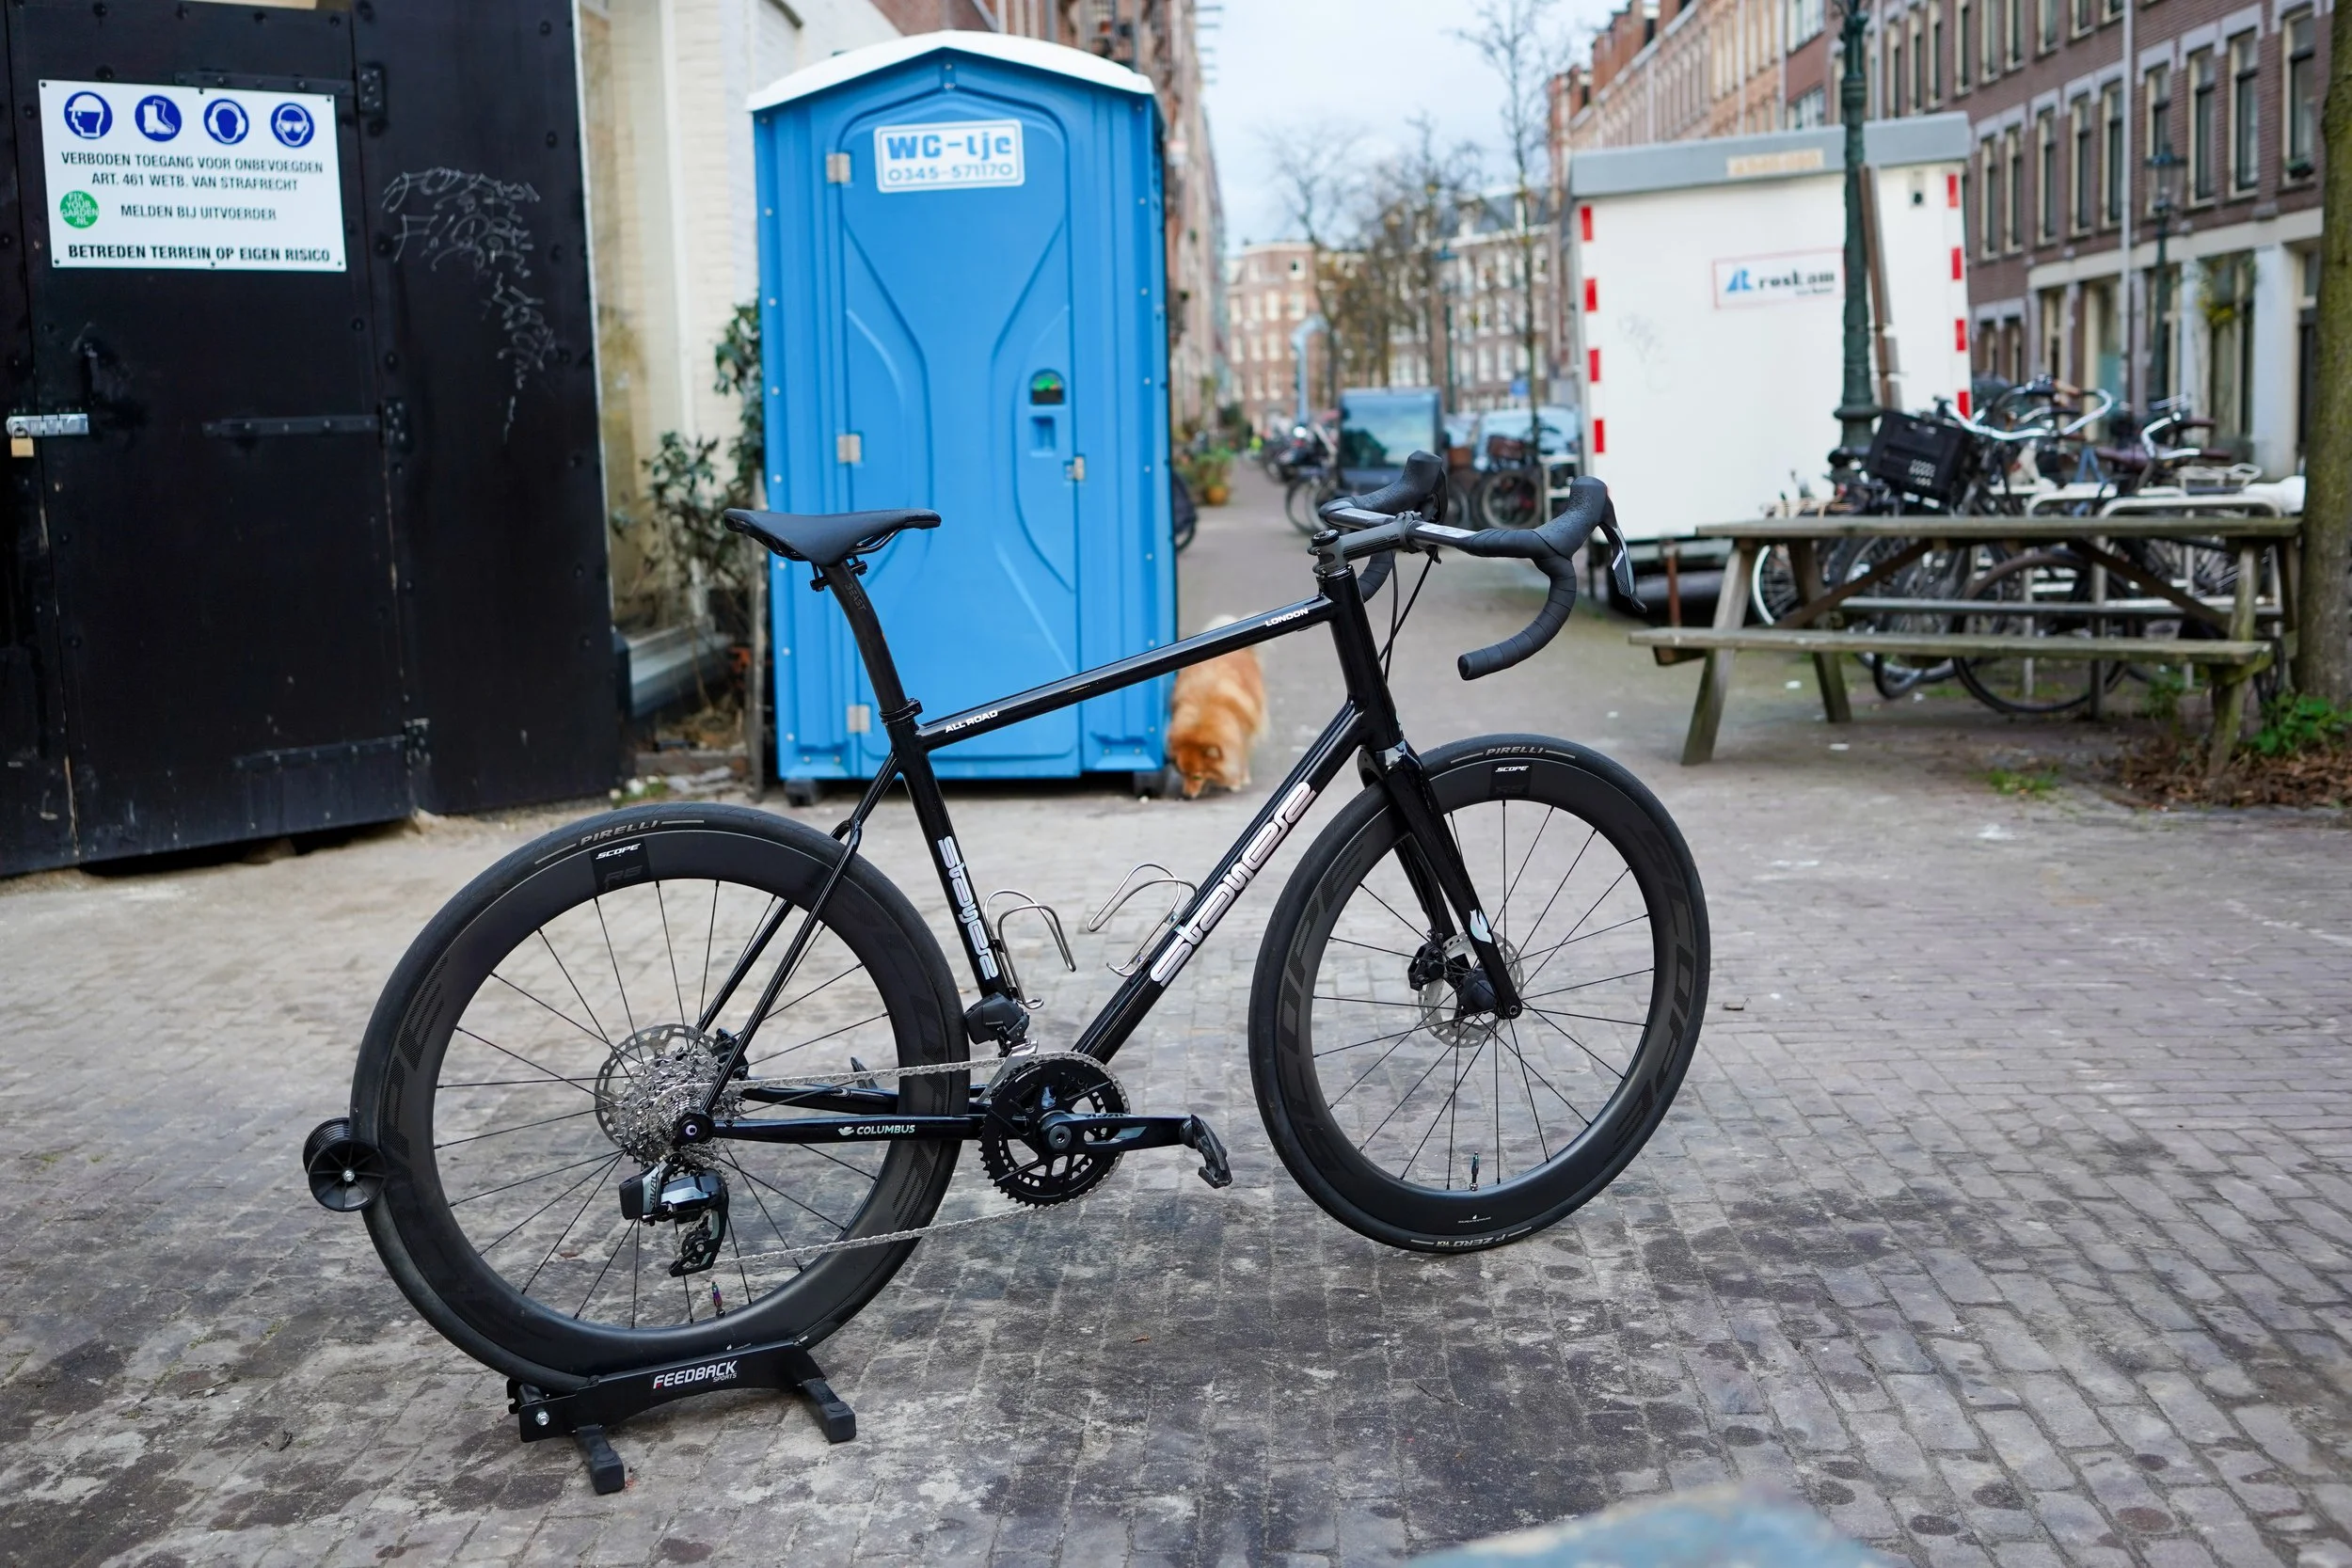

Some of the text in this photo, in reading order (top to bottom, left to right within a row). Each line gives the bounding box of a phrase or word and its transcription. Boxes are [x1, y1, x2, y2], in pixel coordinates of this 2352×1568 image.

[61, 151, 323, 173] VERBODEN TOEGANG VOOR ONBEVOEGDEN
[91, 172, 298, 191] ART. 461 WETB. VAN STRAFRECHT
[68, 192, 84, 201] FIX
[66, 199, 91, 209] YOUR
[60, 208, 100, 217] GARDEN
[120, 204, 278, 220] MELDEN BIJ UITVOERDER
[68, 245, 330, 261] BETREDEN TERREIN OP EIGEN RISICO
[1264, 608, 1310, 627] LONDON
[1486, 745, 1544, 756] PIRELLI
[1495, 765, 1530, 773] SCOPE
[580, 820, 658, 845] PIRELLI
[596, 844, 641, 859] SCOPE
[856, 1124, 915, 1135] COLUMBUS
[1454, 1237, 1494, 1247] ZERO
[1495, 1233, 1506, 1242] P
[653, 1360, 738, 1389] FEEDBACK
[712, 1372, 738, 1384] SPORTS
